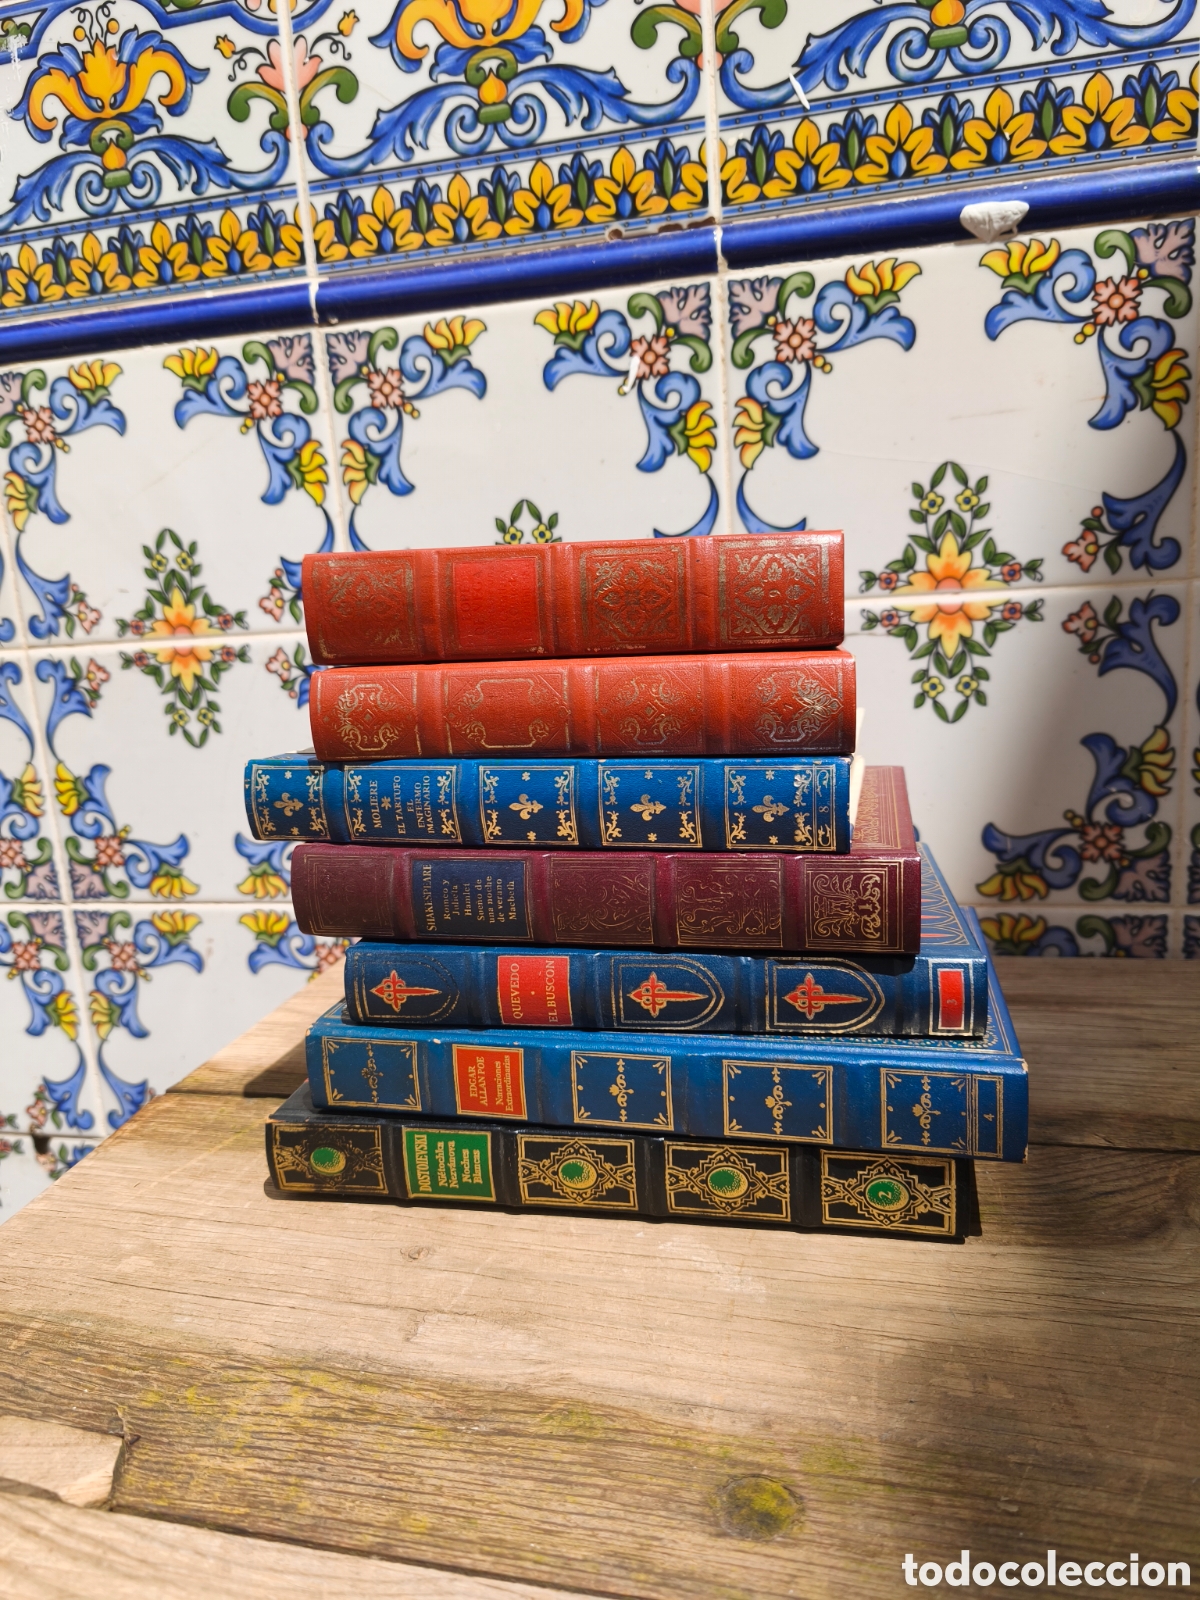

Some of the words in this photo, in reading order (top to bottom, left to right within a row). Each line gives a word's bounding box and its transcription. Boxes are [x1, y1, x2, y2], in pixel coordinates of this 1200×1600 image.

[370, 780, 382, 828] MOLIERE
[393, 776, 403, 821] TARTUFO
[406, 799, 414, 812] EL
[414, 782, 425, 828] ENFERMO
[423, 775, 435, 834] IMAGINARIO
[818, 805, 829, 813] 8
[398, 823, 406, 834] EL
[422, 864, 437, 931] SHAKESPEARE
[451, 885, 460, 915] Julieta
[463, 883, 472, 916] Hamlet
[475, 879, 483, 891] de
[485, 875, 493, 905] noche
[507, 881, 517, 920] Macbeth
[443, 887, 451, 920] Romeo
[476, 893, 485, 921] Sueño
[487, 907, 495, 923] una
[497, 912, 505, 923] de
[510, 963, 523, 1019] QUEVEDO
[545, 960, 556, 1007] BUSCON
[549, 1009, 558, 1022] EL
[468, 1065, 478, 1098] EDGAR
[476, 1056, 486, 1075] POE
[478, 1076, 489, 1107] ALLAN
[494, 1061, 504, 1106] Narraciones
[503, 1054, 514, 1112] Extraordinarias
[983, 1113, 995, 1121] 4
[414, 1134, 432, 1192] DOSTOIEVSKI
[460, 1148, 472, 1183] Noches
[472, 1149, 483, 1184] Blancas
[878, 1190, 892, 1199] 2
